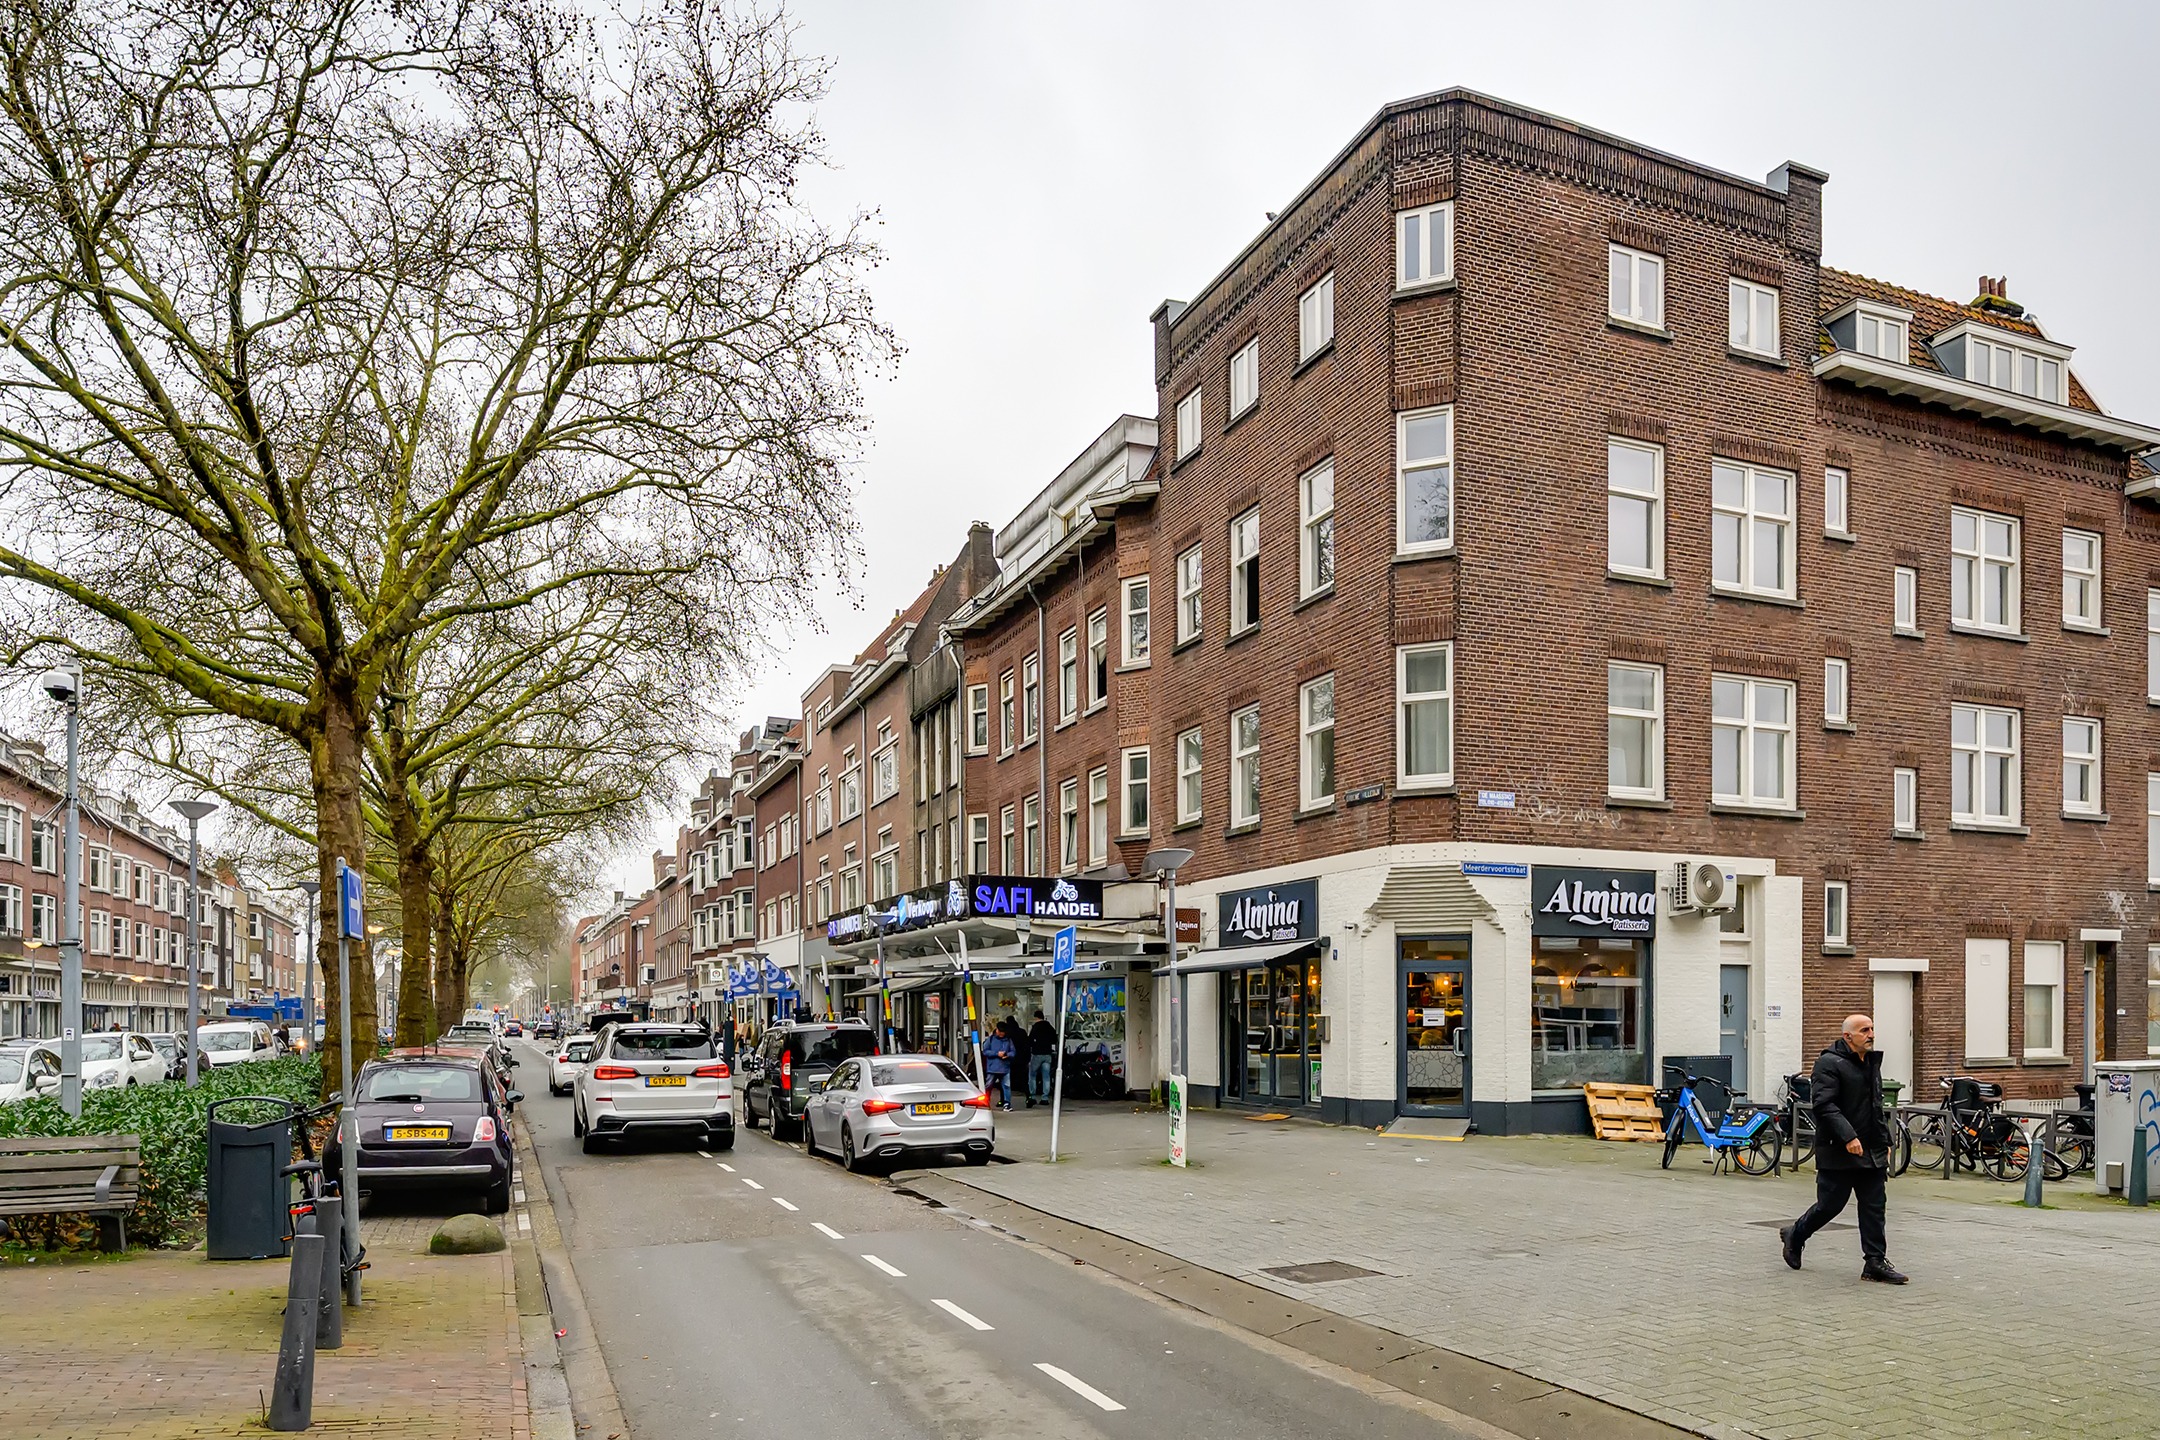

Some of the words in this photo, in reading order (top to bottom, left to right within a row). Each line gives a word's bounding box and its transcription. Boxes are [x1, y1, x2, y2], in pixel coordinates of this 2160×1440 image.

[1464, 863, 1527, 875] Meerdervoortstraat
[975, 885, 1032, 915] SAFI
[1034, 901, 1099, 917] HANDEL
[1540, 879, 1656, 926] Almina
[1226, 890, 1300, 940] Almina
[1612, 918, 1650, 931] Patisserie
[1272, 926, 1298, 941] Patisserie
[1057, 936, 1069, 960] P
[652, 1077, 682, 1085] GTK-21-T
[917, 1104, 952, 1113] R-048-PR
[396, 1129, 444, 1138] 5-SBS-44
